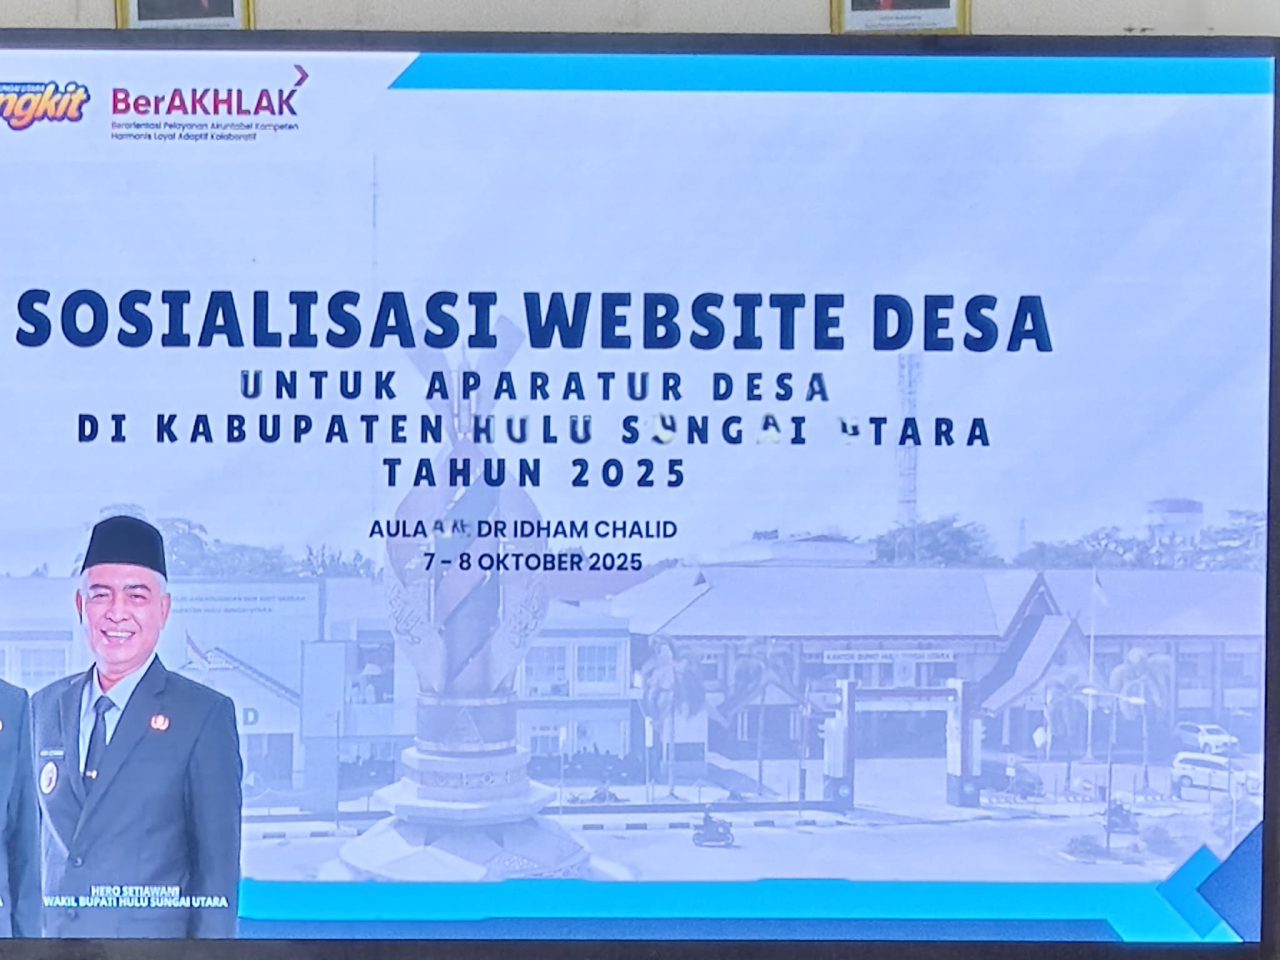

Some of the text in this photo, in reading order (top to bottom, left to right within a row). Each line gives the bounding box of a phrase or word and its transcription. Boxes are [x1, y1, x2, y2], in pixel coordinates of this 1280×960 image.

[112, 88, 297, 116] BerAKHLAK
[16, 289, 1053, 353] SOSIALISASI WEBSITE DESA
[241, 370, 829, 402] UNTUK APARATUR DESA
[78, 414, 126, 443] DI
[156, 414, 443, 444] KABUPATEN
[473, 414, 592, 445] HULU
[382, 458, 684, 488] TAHUN 2025
[369, 520, 428, 538] AULA
[477, 520, 507, 538] DR
[513, 520, 588, 538] IDHAM
[594, 520, 678, 539] CHALID
[423, 552, 436, 571] 7
[459, 552, 472, 571] 8
[477, 552, 583, 571] OKTOBER
[588, 552, 643, 572] 2025
[43, 896, 228, 908] WAKIL BUPATI HULU SUNGAI UTARA
[91, 885, 121, 897] HERO
